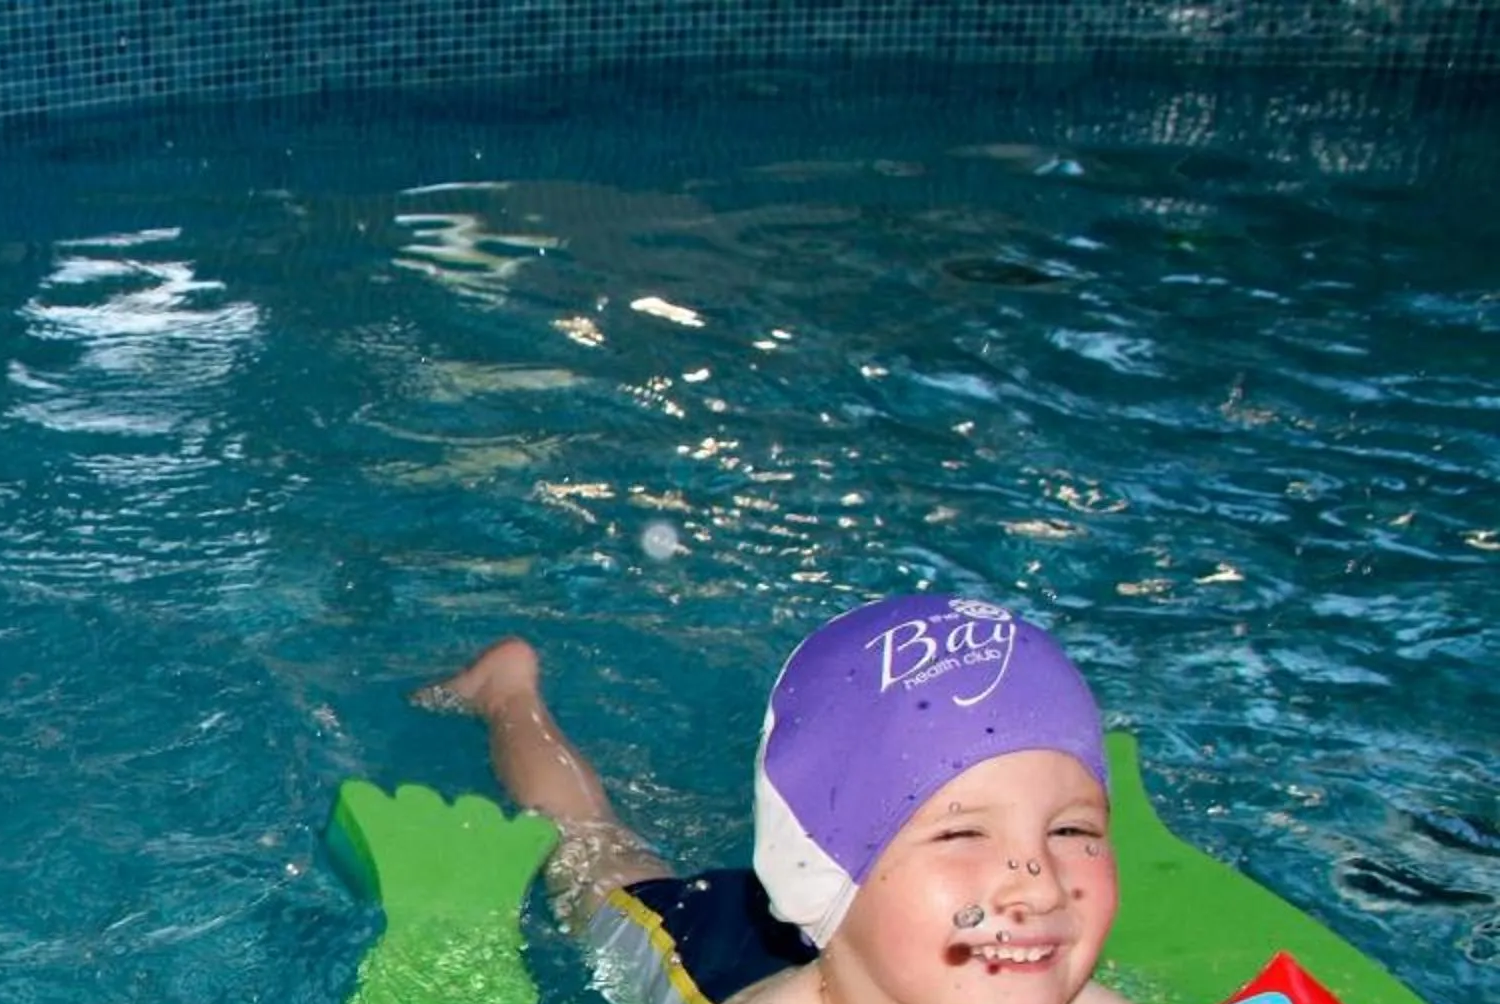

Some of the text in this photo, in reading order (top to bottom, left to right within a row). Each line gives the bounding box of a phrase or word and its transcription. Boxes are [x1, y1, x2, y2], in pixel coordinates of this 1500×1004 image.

[864, 619, 1018, 707] Bay
[903, 648, 1002, 691] health club
